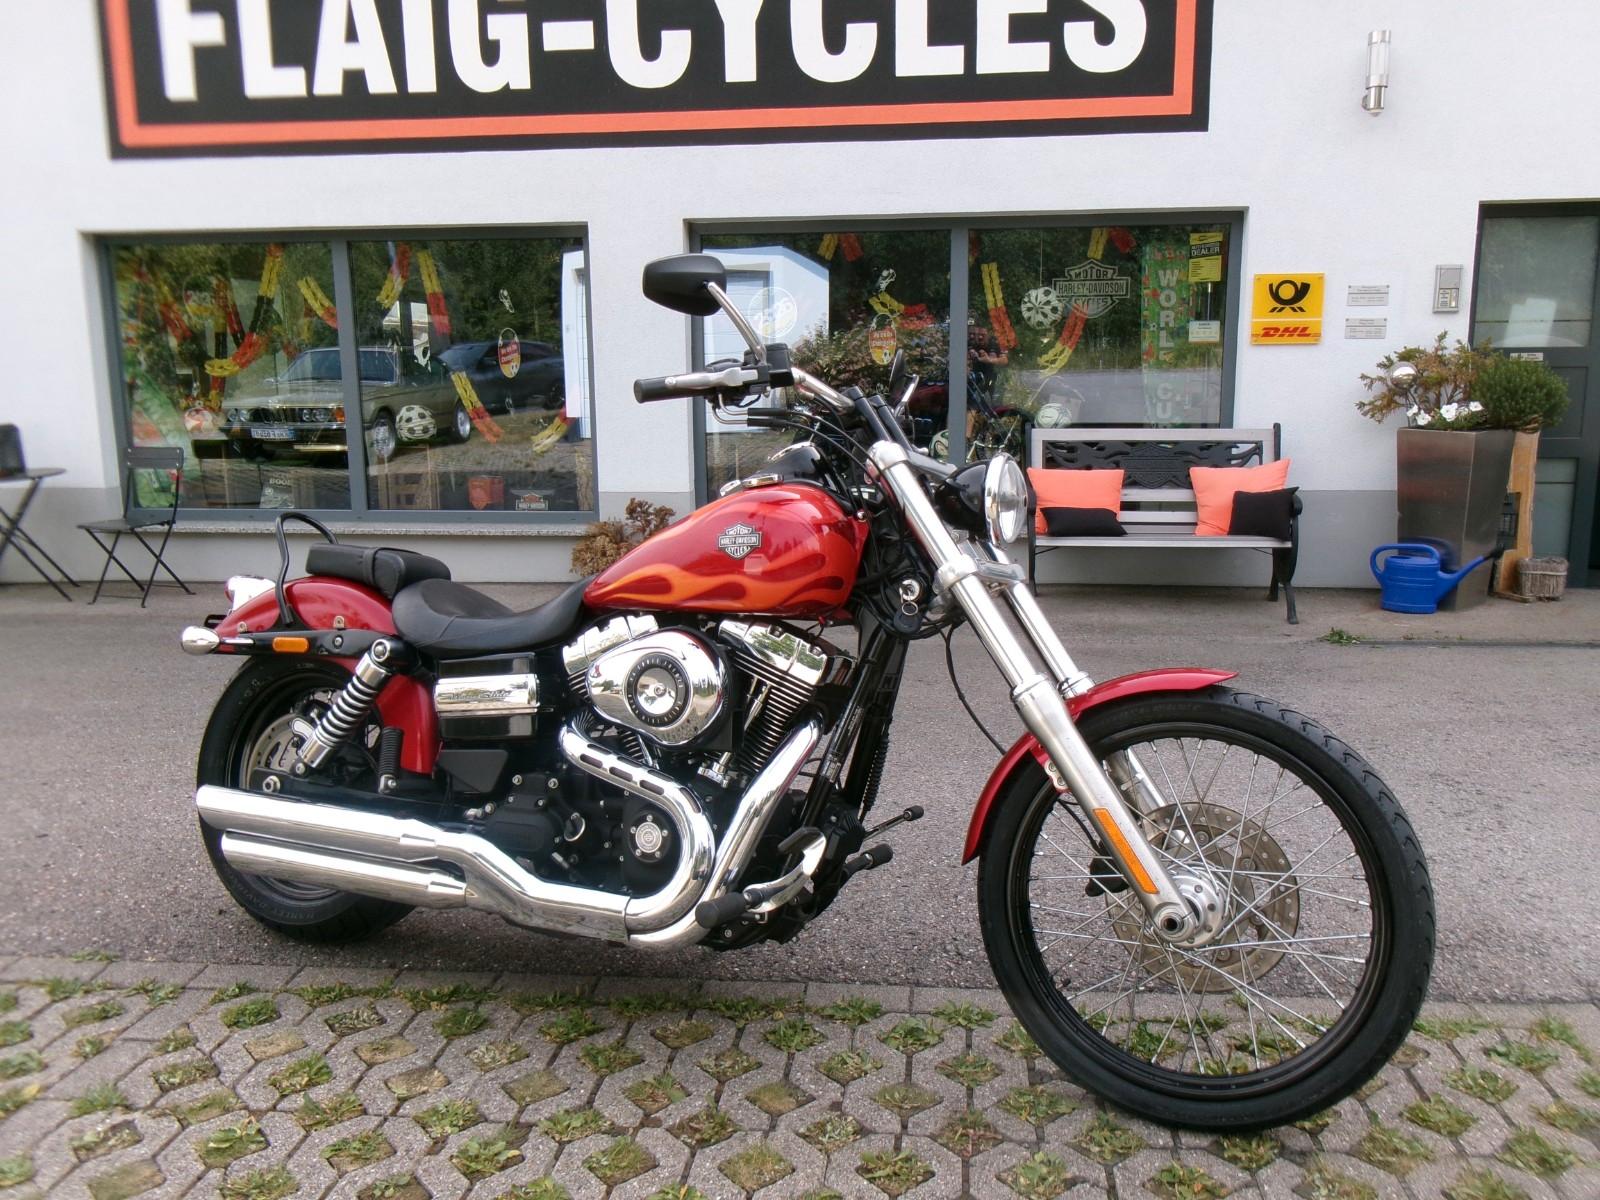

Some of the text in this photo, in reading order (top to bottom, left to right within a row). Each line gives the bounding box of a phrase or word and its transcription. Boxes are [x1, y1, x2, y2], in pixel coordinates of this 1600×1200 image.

[1191, 246, 1220, 256] DEALER
[1074, 268, 1109, 279] MOTOR
[1058, 281, 1125, 295] HARLEY-DAVIDSON
[1260, 326, 1312, 338] DHL
